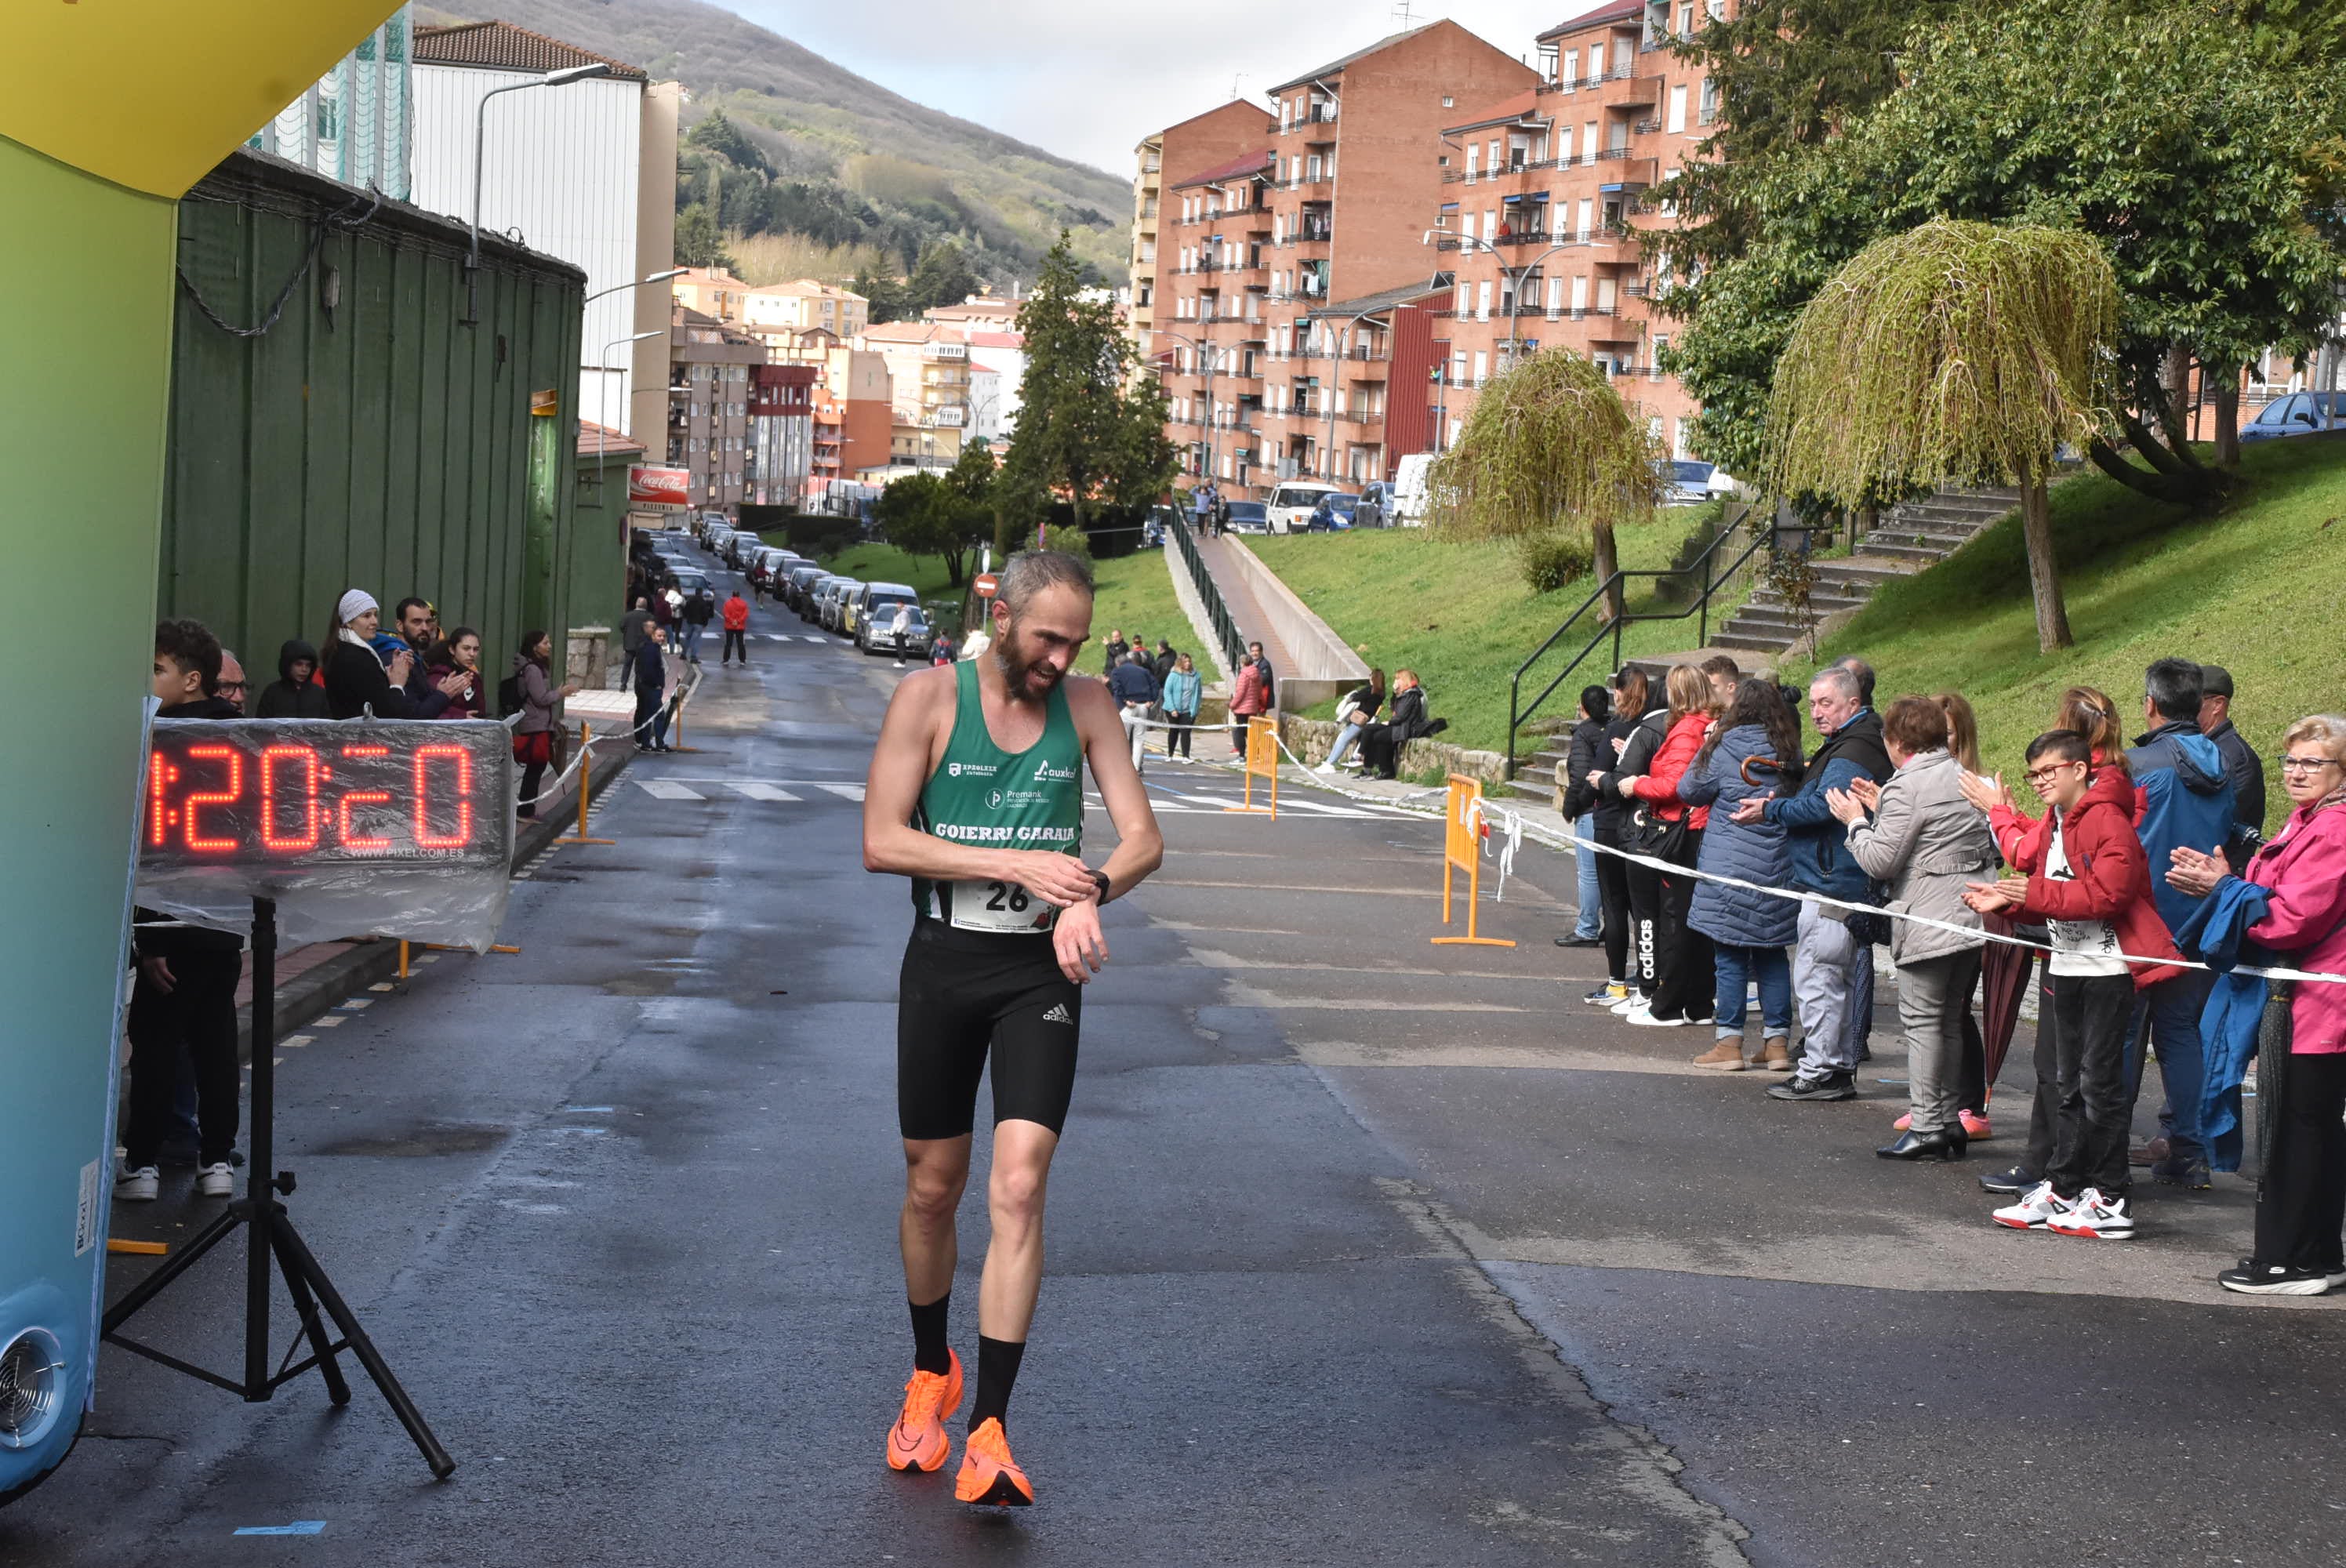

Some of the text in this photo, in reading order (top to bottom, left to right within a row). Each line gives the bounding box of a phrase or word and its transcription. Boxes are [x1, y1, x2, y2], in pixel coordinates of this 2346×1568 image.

[935, 823, 1075, 841] GOIERRI GARAIA
[986, 881, 1029, 913] 26
[1639, 919, 1654, 979] adidas
